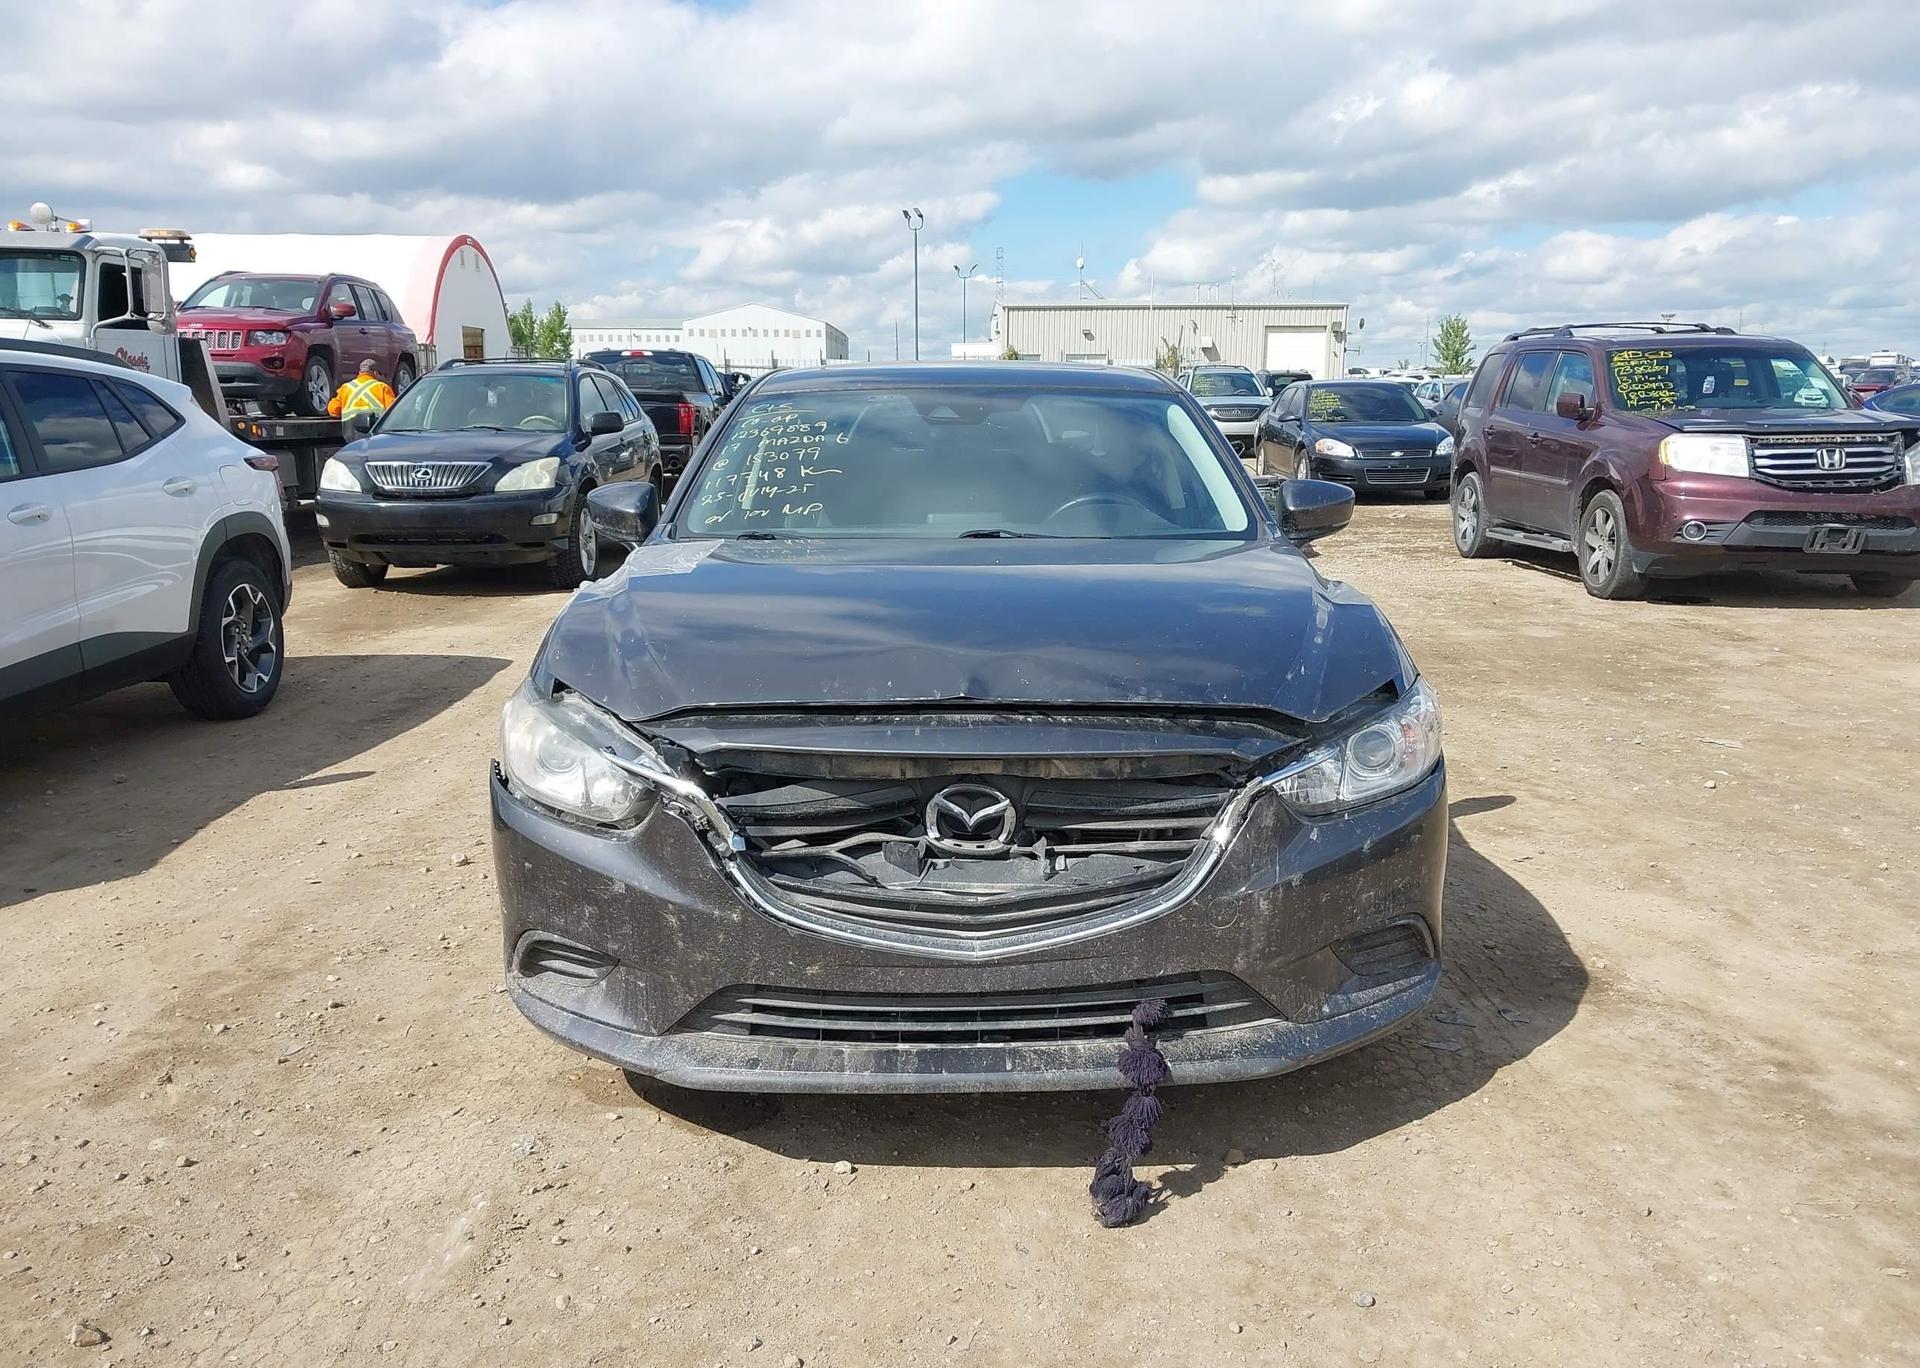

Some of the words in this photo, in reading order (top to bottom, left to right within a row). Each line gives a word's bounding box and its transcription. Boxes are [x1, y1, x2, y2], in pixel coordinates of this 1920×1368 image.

[758, 435, 825, 448] MAZDA
[836, 432, 850, 444] 6
[746, 446, 822, 466] 153079
